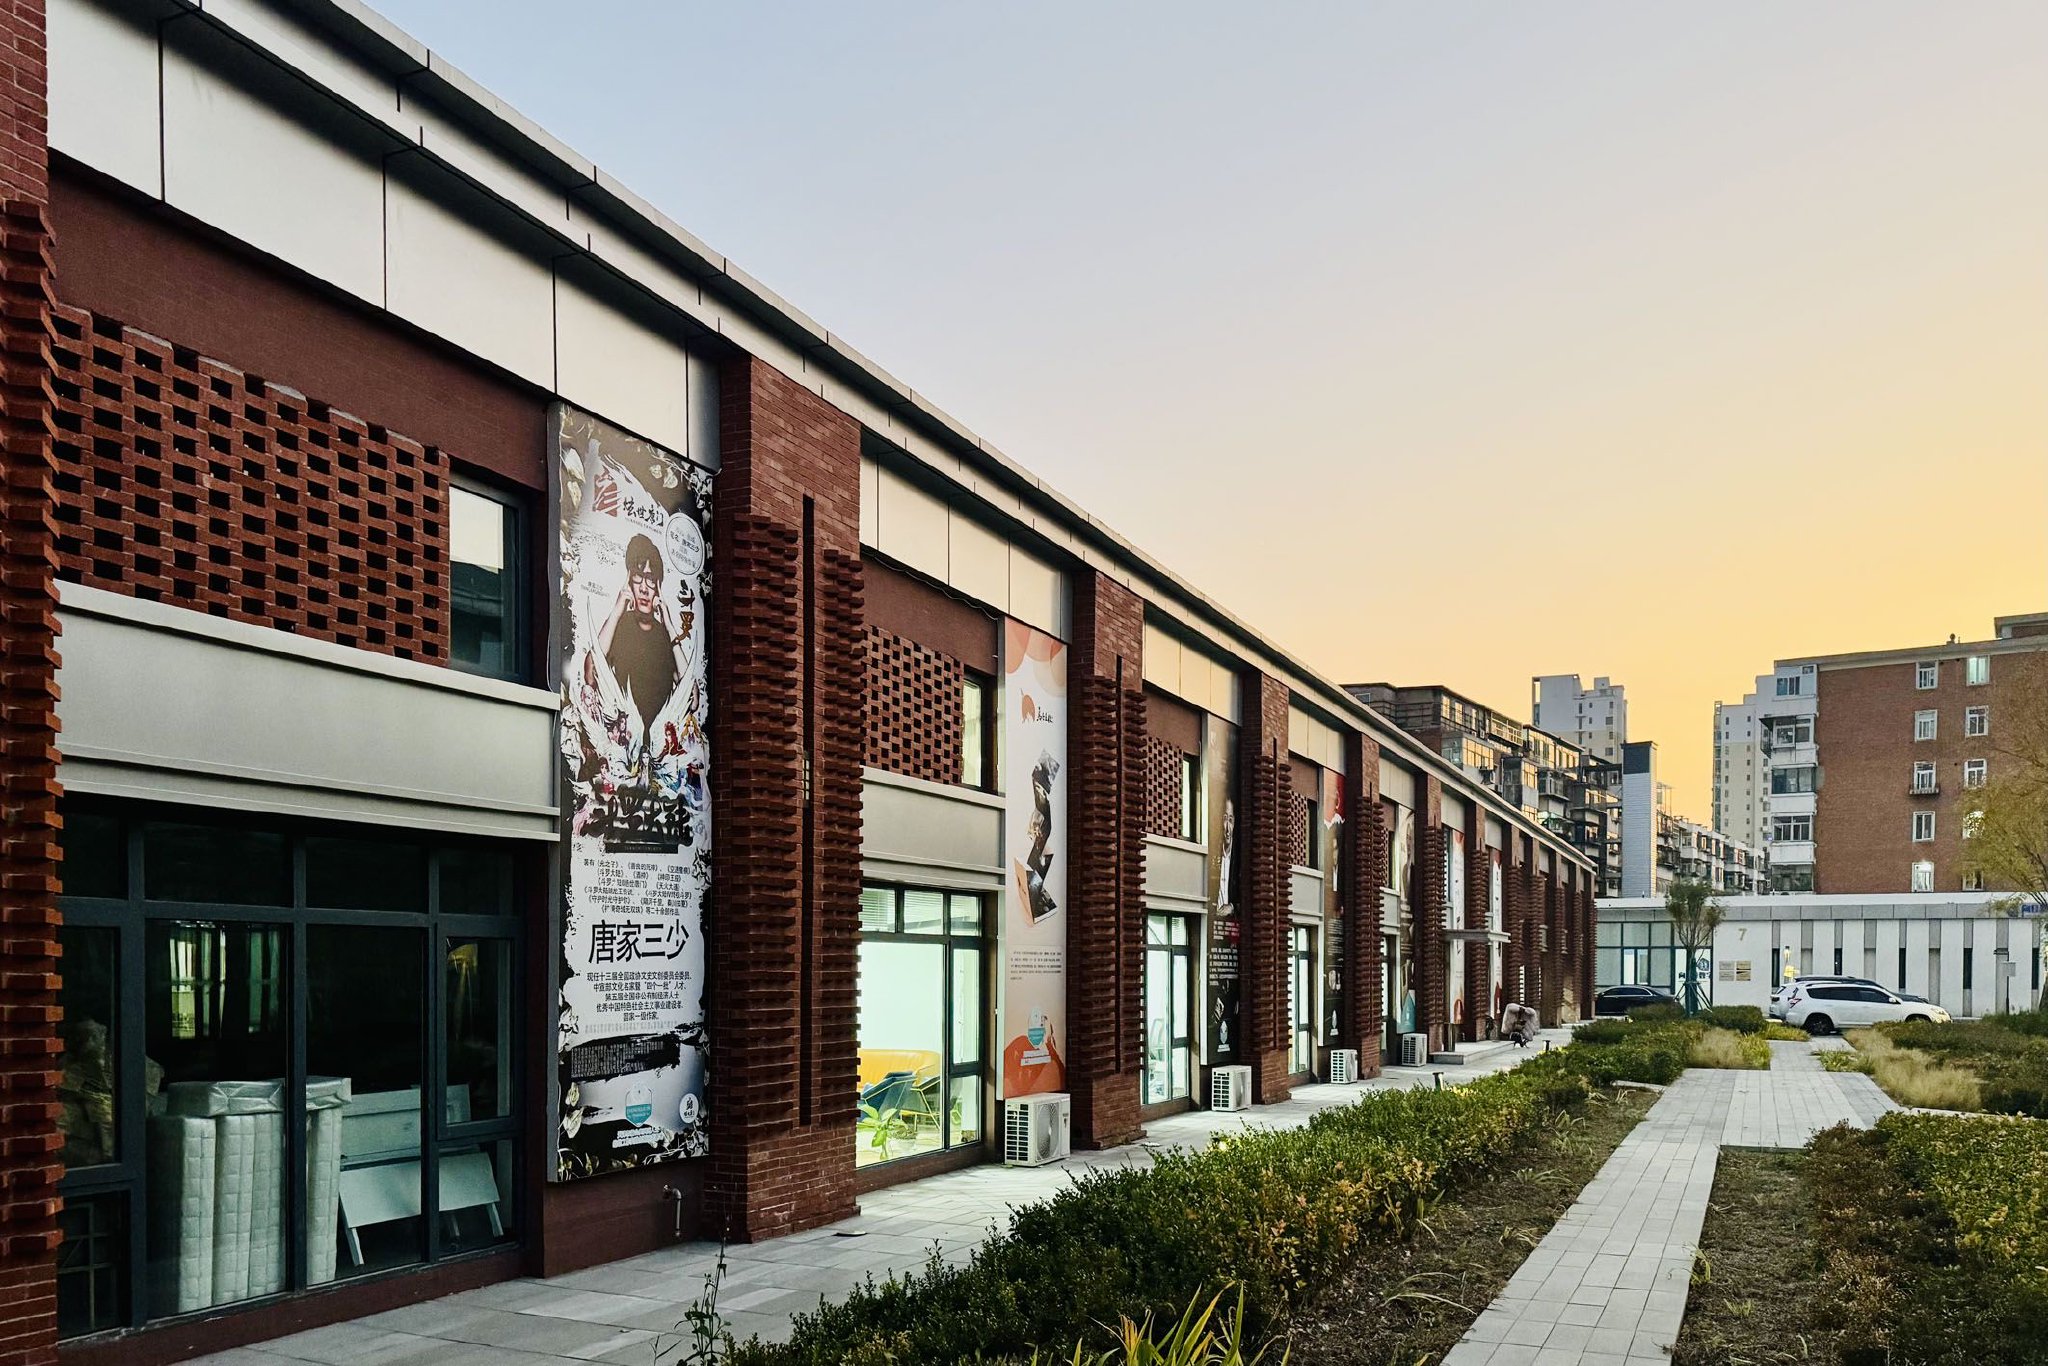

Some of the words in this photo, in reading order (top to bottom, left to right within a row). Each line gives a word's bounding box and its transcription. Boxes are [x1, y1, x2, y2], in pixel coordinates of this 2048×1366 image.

[588, 919, 690, 964] 唐家三少
[1738, 928, 1748, 941] 7
